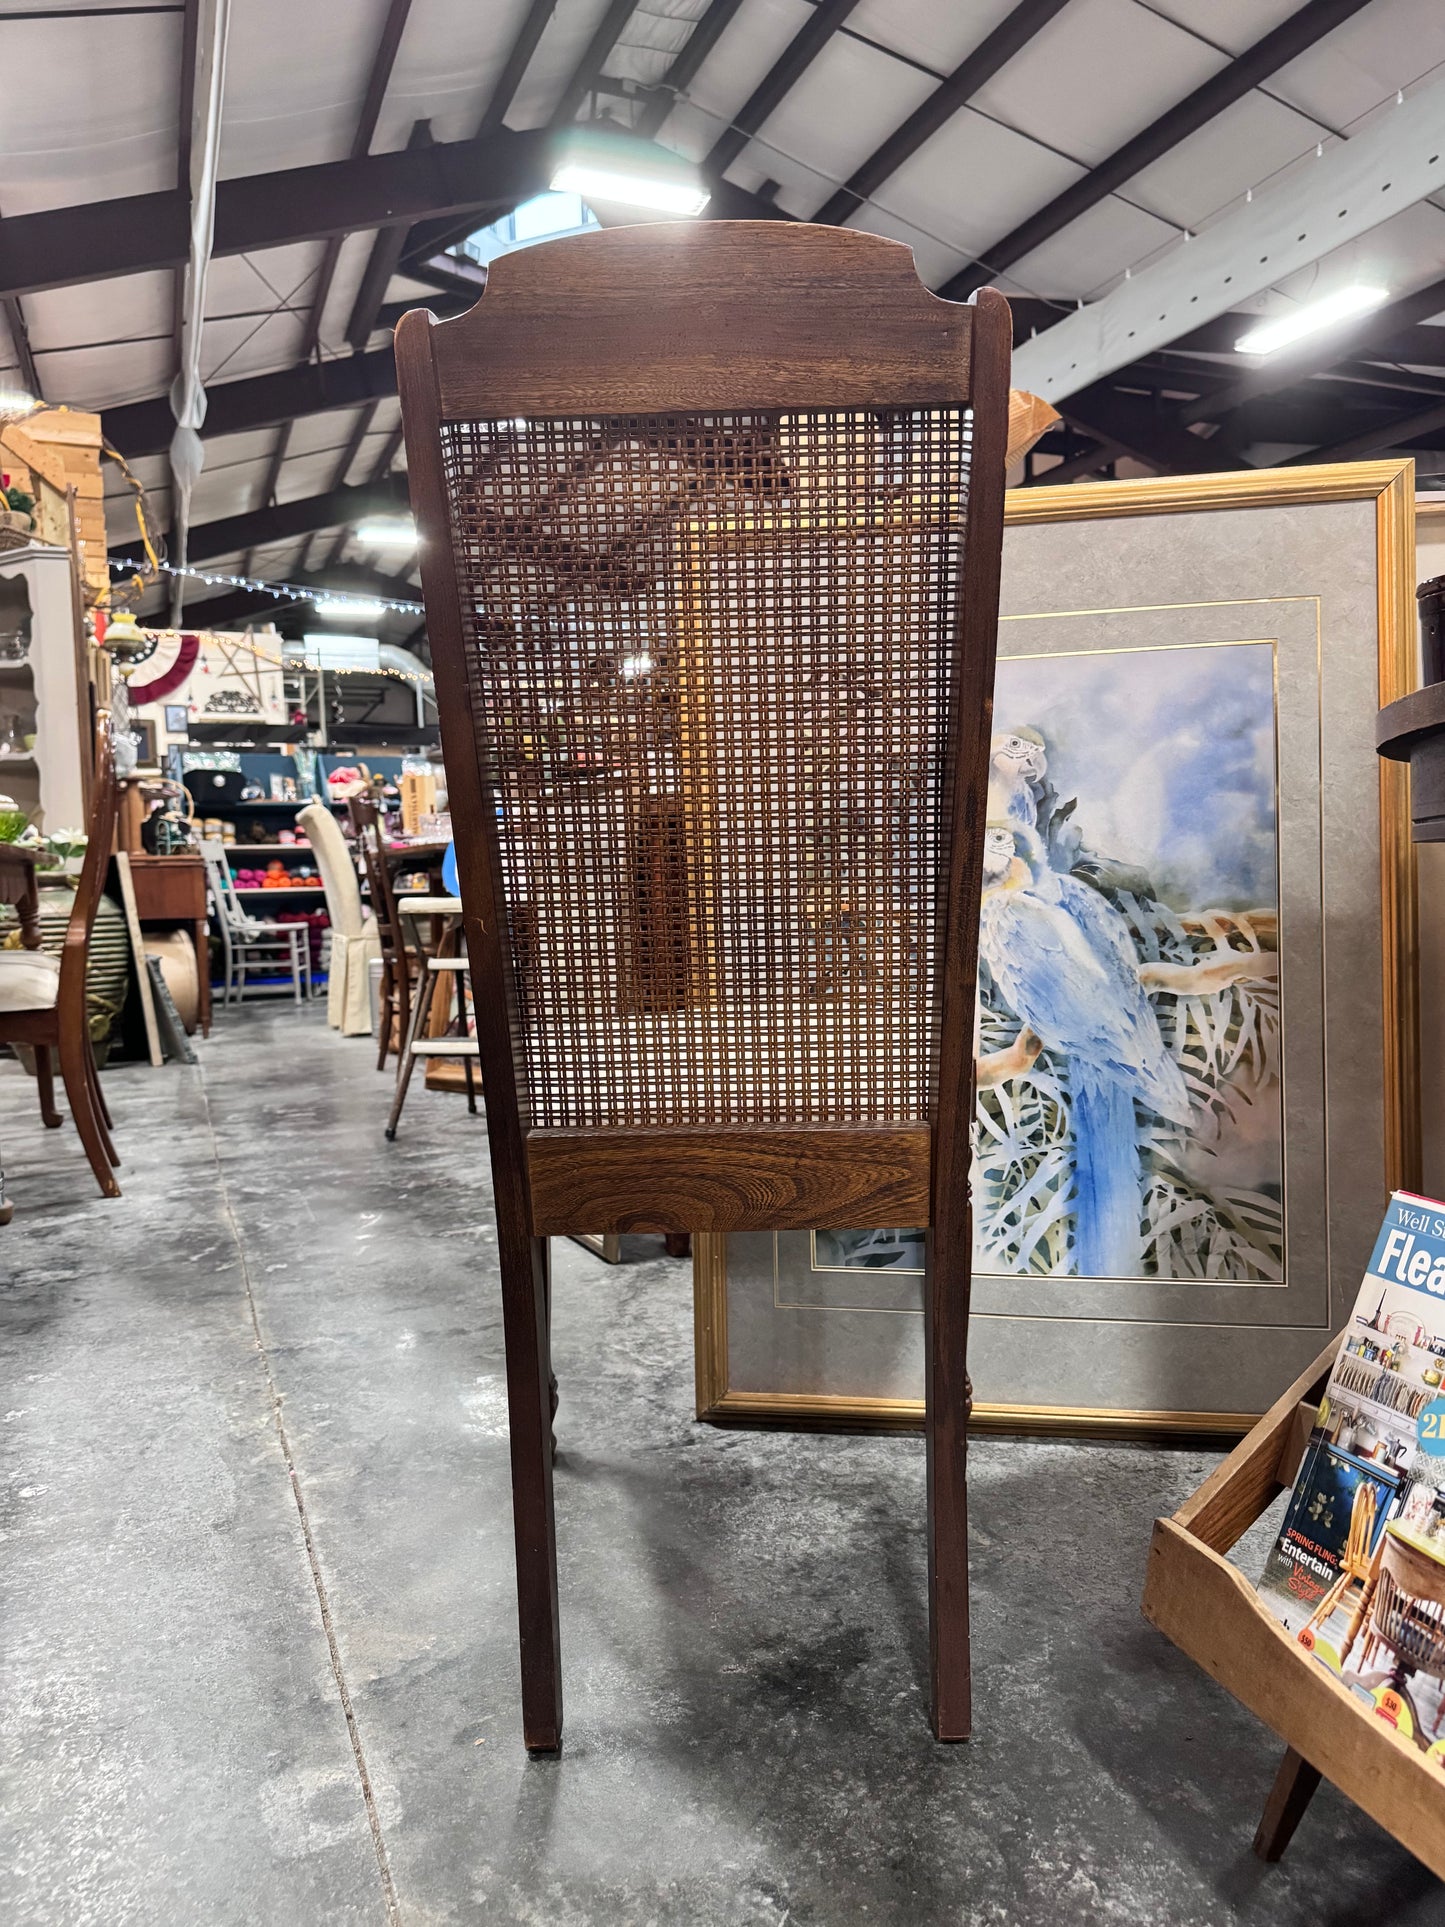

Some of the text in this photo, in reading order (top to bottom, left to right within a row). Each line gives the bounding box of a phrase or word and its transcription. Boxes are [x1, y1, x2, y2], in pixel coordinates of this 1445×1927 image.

[1398, 1207, 1430, 1232] Well
[1377, 1228, 1445, 1295] Flea
[1281, 1537, 1334, 1581] Entertain
[1286, 1527, 1338, 1565] SPRING FLING:
[1277, 1553, 1325, 1596] with Vintage
